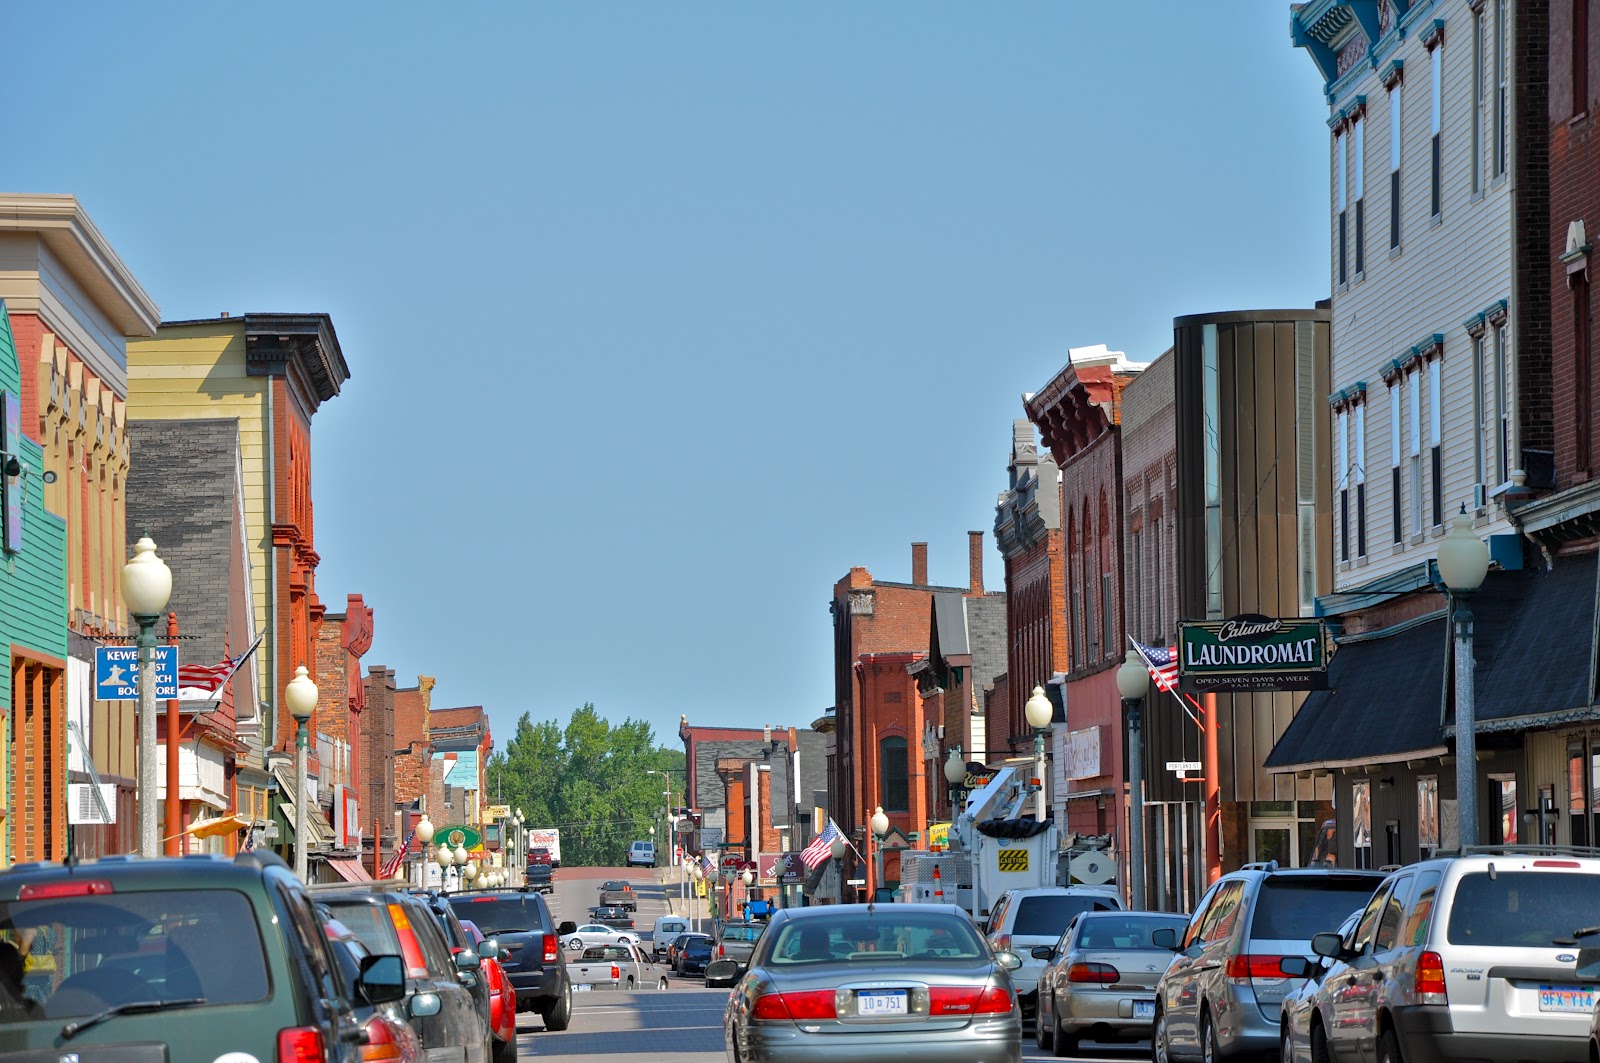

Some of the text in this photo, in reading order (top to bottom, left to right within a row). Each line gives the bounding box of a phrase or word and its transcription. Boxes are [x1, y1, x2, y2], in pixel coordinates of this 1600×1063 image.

[1217, 619, 1283, 642] Calumet
[107, 651, 168, 661] KEWEW
[1187, 638, 1316, 666] LAUNDROMAT
[130, 663, 167, 672] BAST
[132, 675, 172, 684] CRCH
[118, 686, 176, 696] BOOORE
[864, 997, 874, 1010] 10
[885, 996, 901, 1009] 751
[1542, 991, 1593, 1007] 9FX Y14
